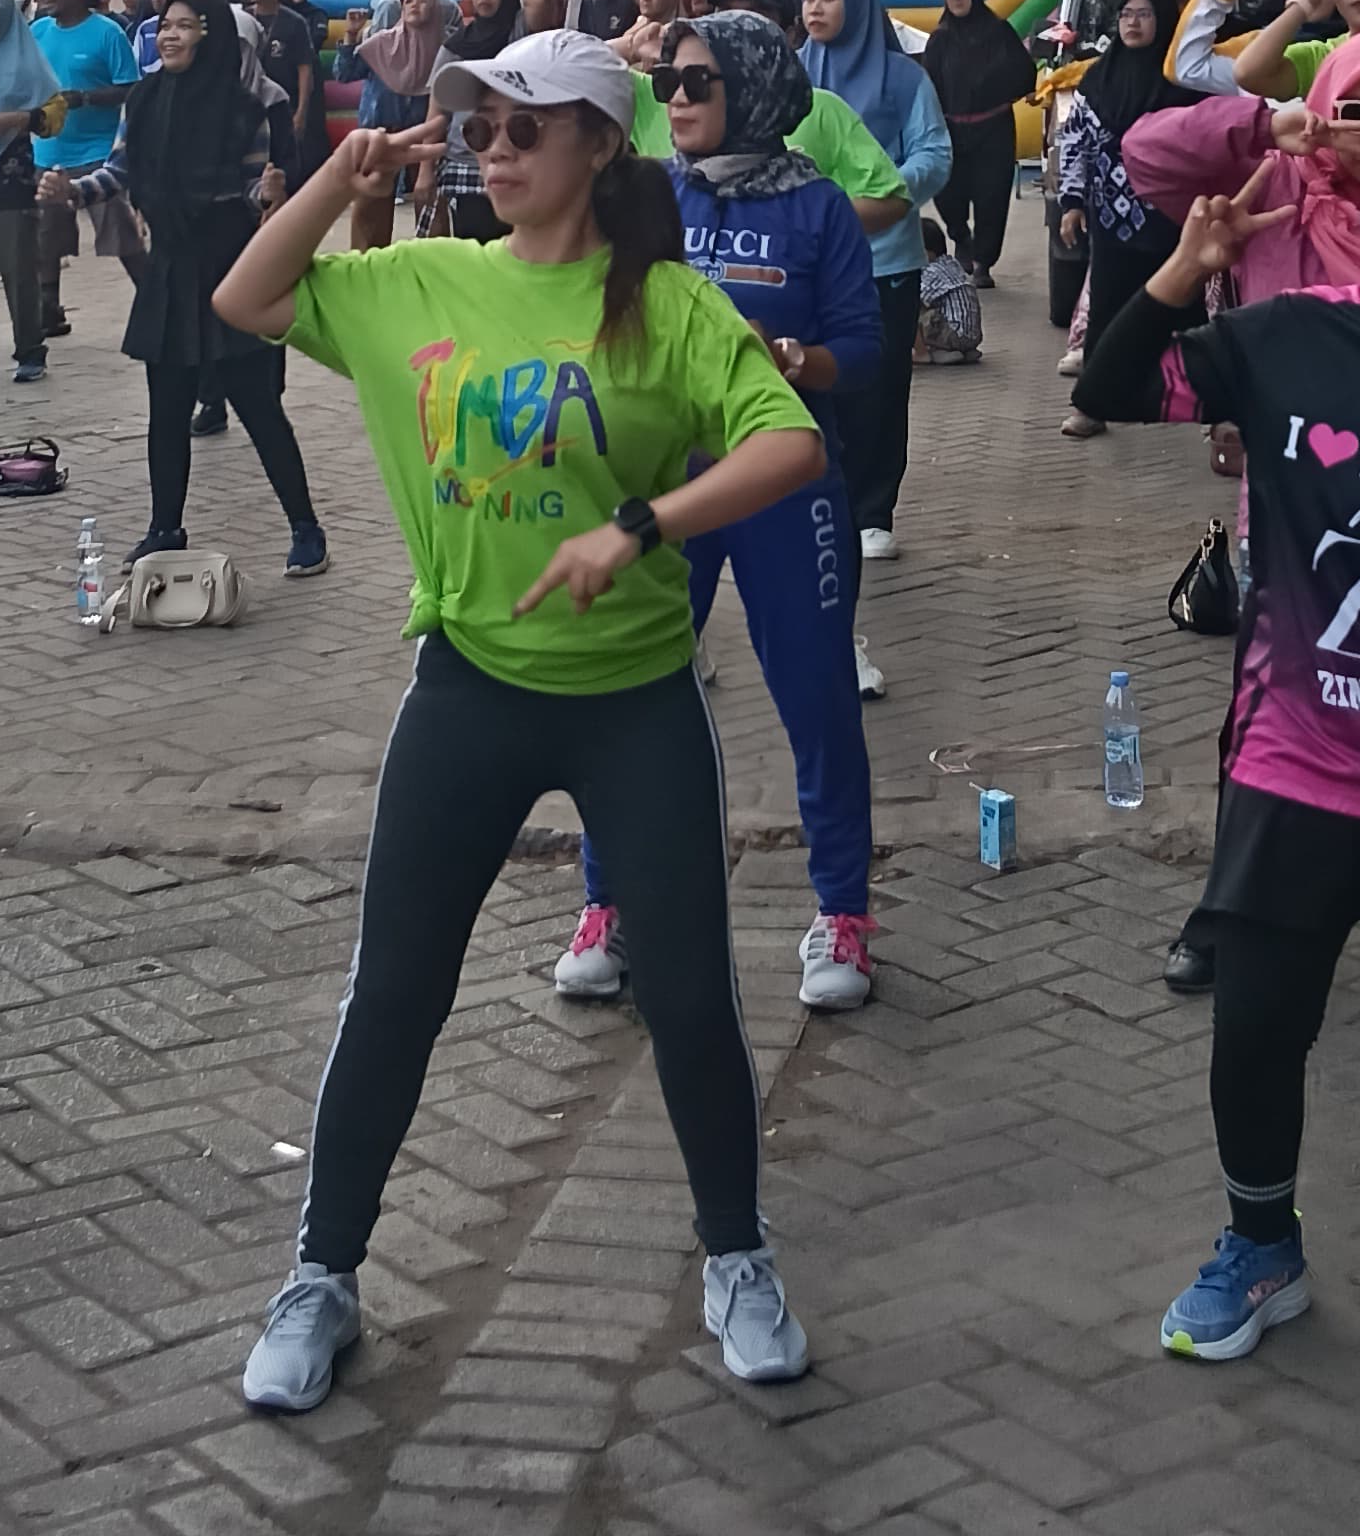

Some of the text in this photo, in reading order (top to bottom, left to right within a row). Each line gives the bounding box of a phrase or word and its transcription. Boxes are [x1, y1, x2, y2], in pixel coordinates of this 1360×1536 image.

[683, 226, 771, 259] UCCI
[1284, 415, 1305, 460] I
[811, 498, 839, 609] GUCCI
